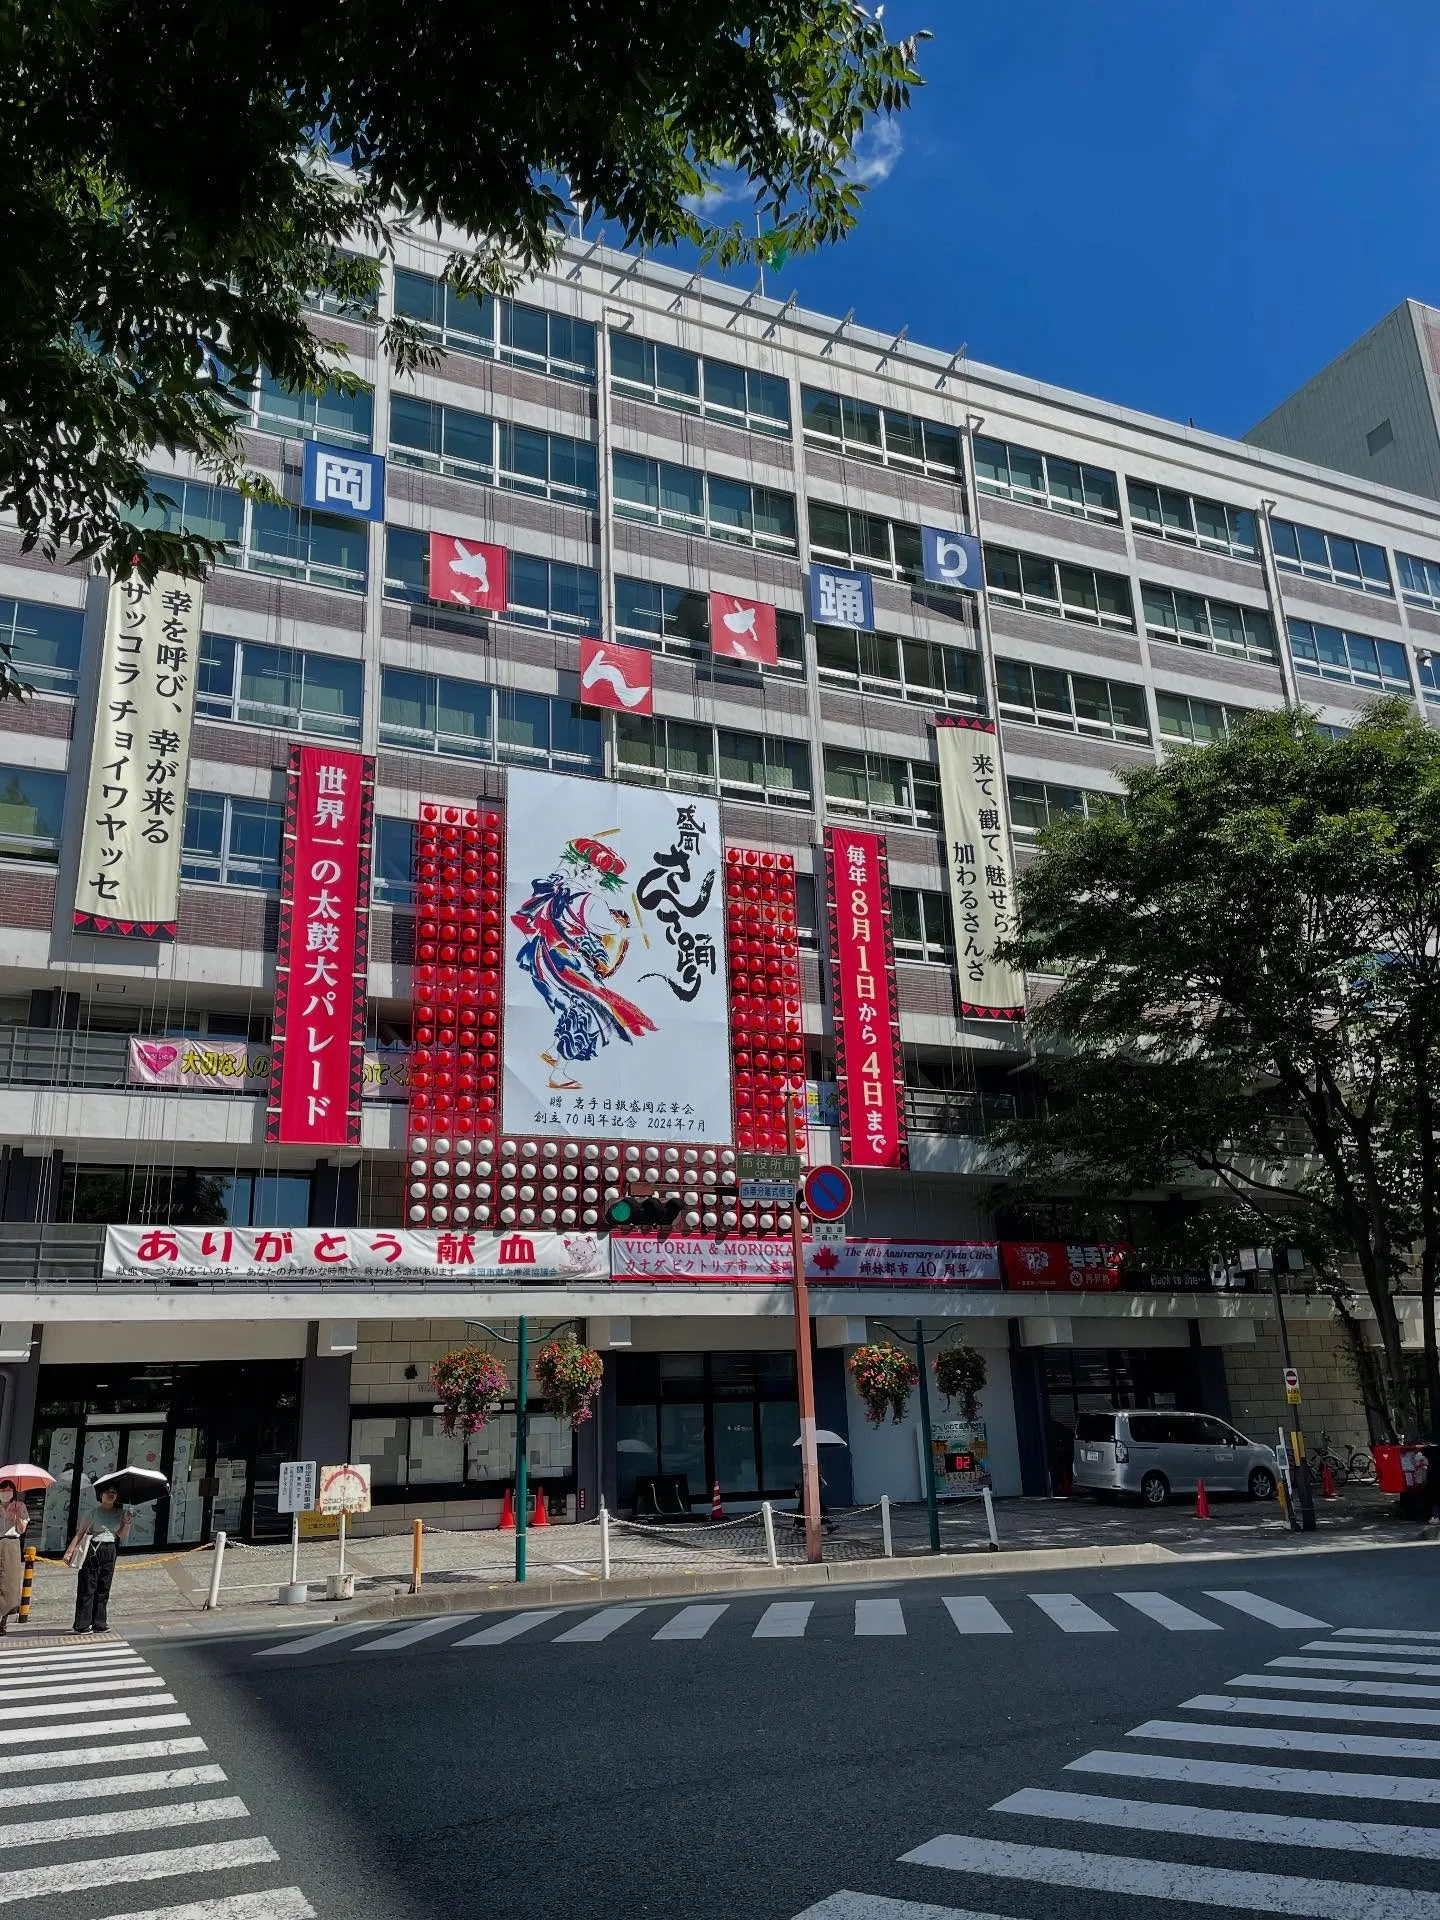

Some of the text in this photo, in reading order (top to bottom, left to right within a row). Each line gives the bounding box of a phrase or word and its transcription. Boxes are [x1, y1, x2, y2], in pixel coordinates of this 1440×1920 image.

[316, 452, 372, 511] 岡
[448, 539, 490, 605] さ
[936, 536, 969, 577] り
[819, 574, 864, 624] 踊
[723, 600, 759, 656] さ
[582, 650, 650, 707] ん
[953, 841, 985, 982] 加わるさんさ
[302, 765, 348, 1127] 世界一の太鼓大パレード
[846, 844, 887, 1155] 毎年8月1日から4日まで
[181, 1050, 271, 1078] 大切な人の
[550, 1096, 562, 1109] 贈
[534, 1110, 706, 1133] 創立70周年記念 2024年7月
[742, 1157, 796, 1171] 市役所前
[755, 1170, 783, 1178] City Hall
[625, 1241, 794, 1257] VICTORIA & MORIOKA
[625, 1258, 666, 1273] カナダ
[672, 1259, 749, 1274] ビクトリア市
[844, 1247, 993, 1262] The 40th Anniversary of Twin Cities
[859, 1261, 969, 1277] 姉妹都市 40 周年
